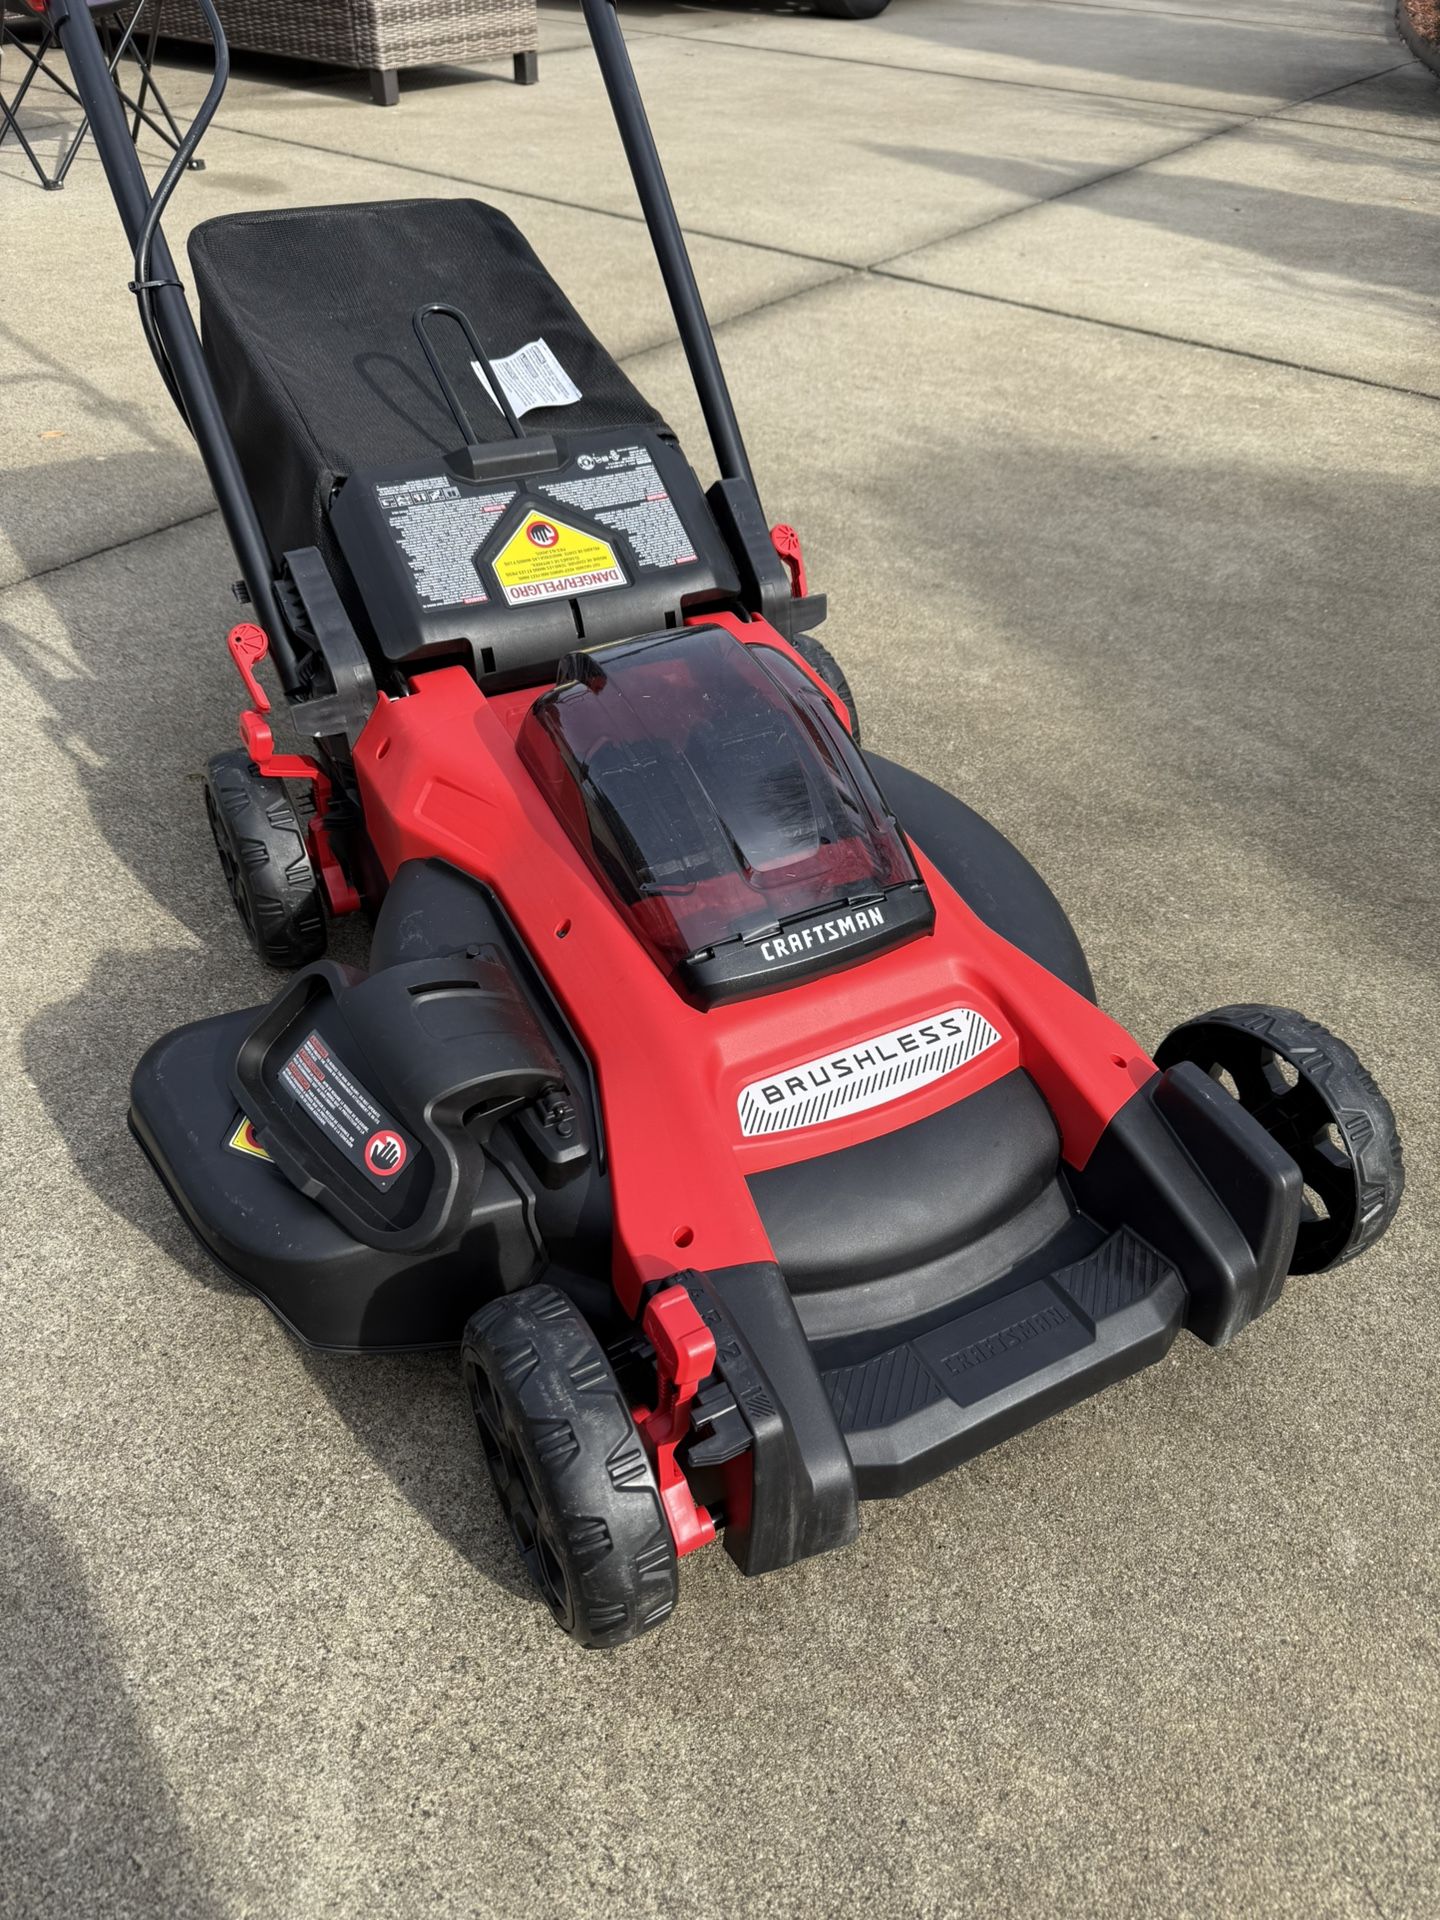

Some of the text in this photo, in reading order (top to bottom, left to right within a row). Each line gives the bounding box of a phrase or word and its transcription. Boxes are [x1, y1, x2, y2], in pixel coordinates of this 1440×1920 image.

[510, 569, 619, 599] DANGER/PELIGRO
[760, 907, 885, 961] CRAFTSMAN
[761, 1017, 962, 1105] BRUSHLESS
